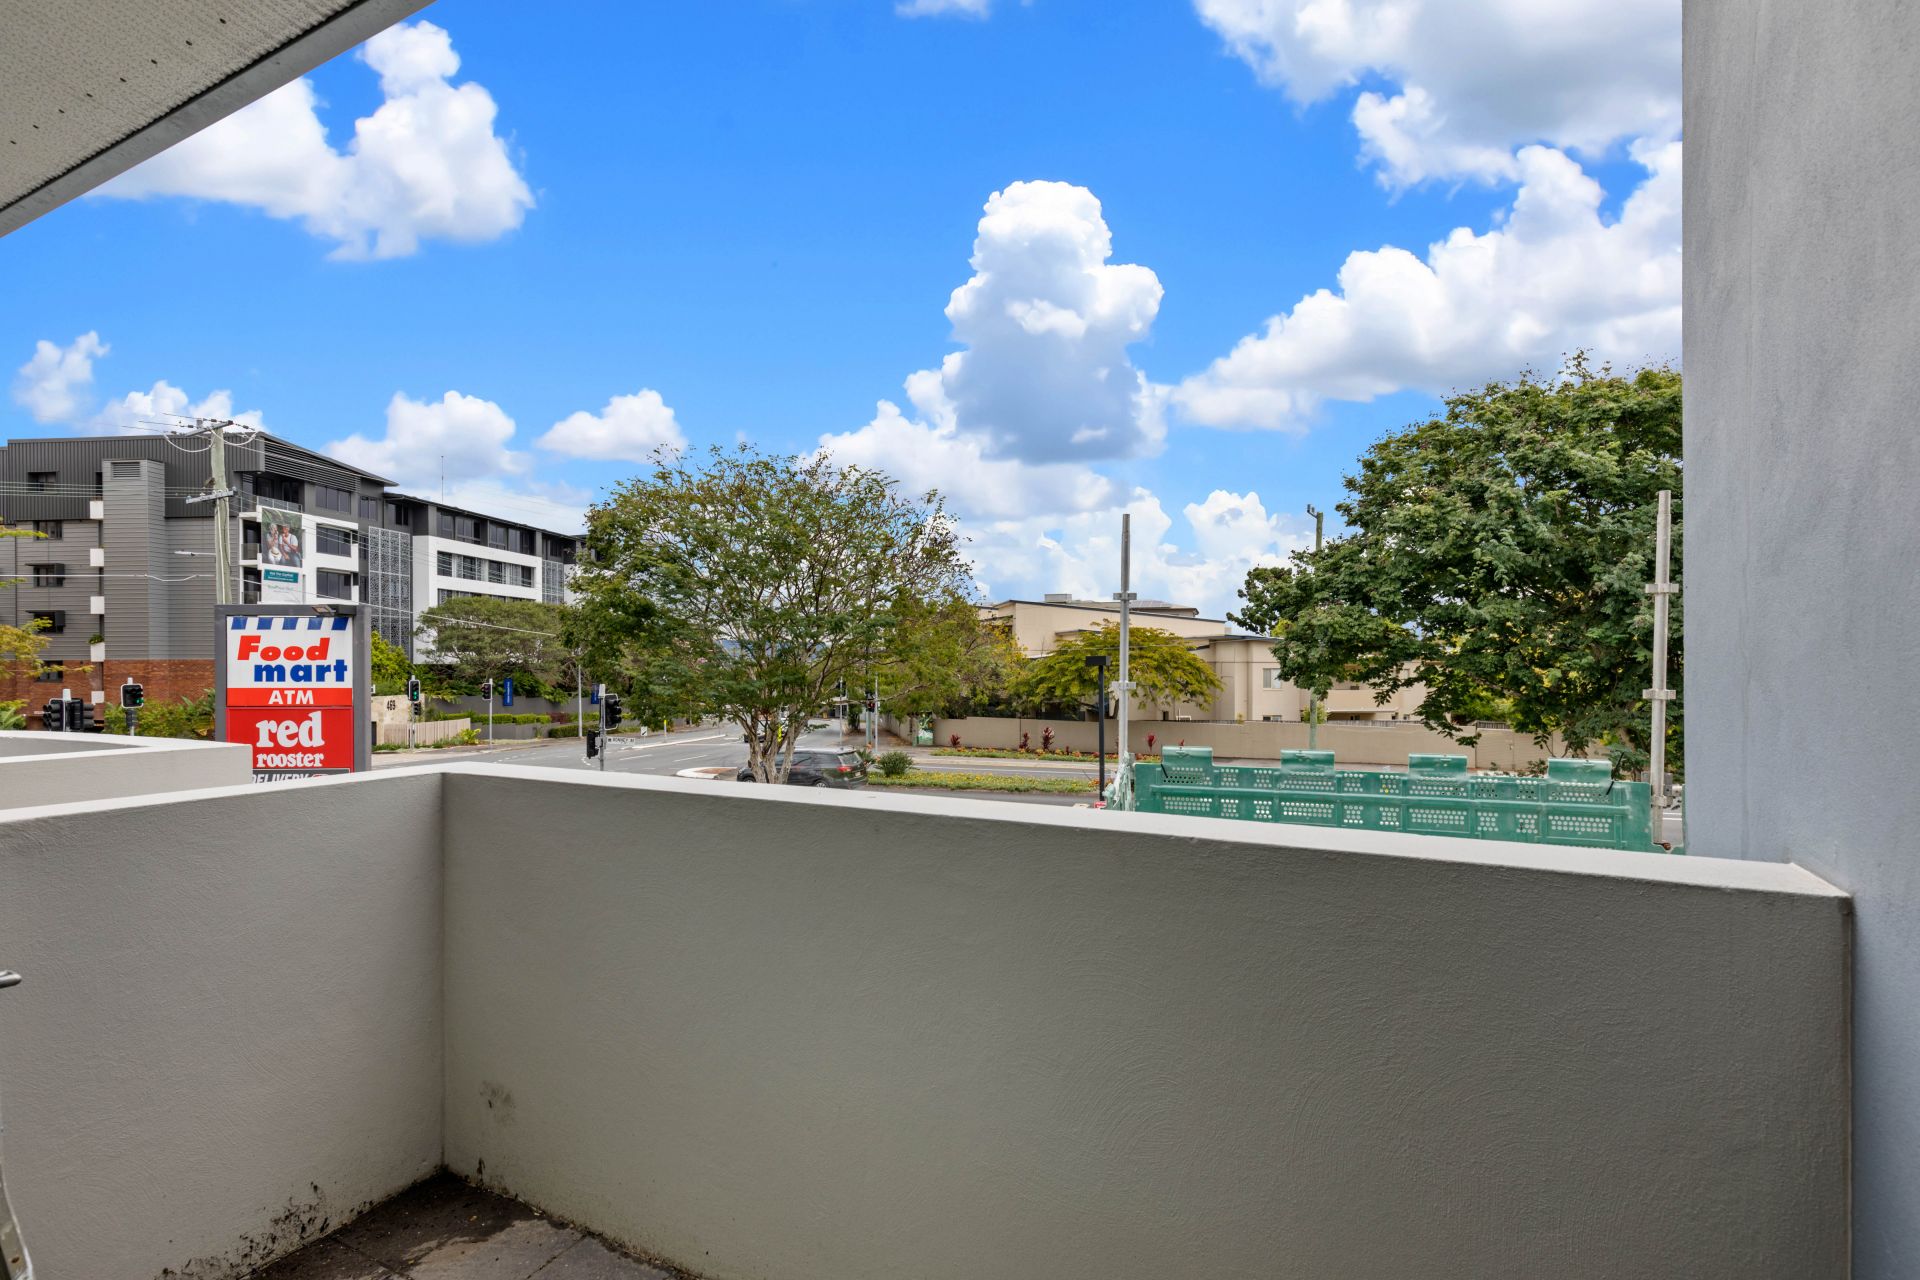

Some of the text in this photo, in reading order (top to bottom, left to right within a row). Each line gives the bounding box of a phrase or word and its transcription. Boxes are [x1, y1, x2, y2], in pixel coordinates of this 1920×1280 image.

[237, 635, 330, 661] Food
[254, 659, 348, 682] mart
[268, 690, 315, 705] ATM
[255, 710, 325, 748] red
[256, 751, 325, 768] rooster
